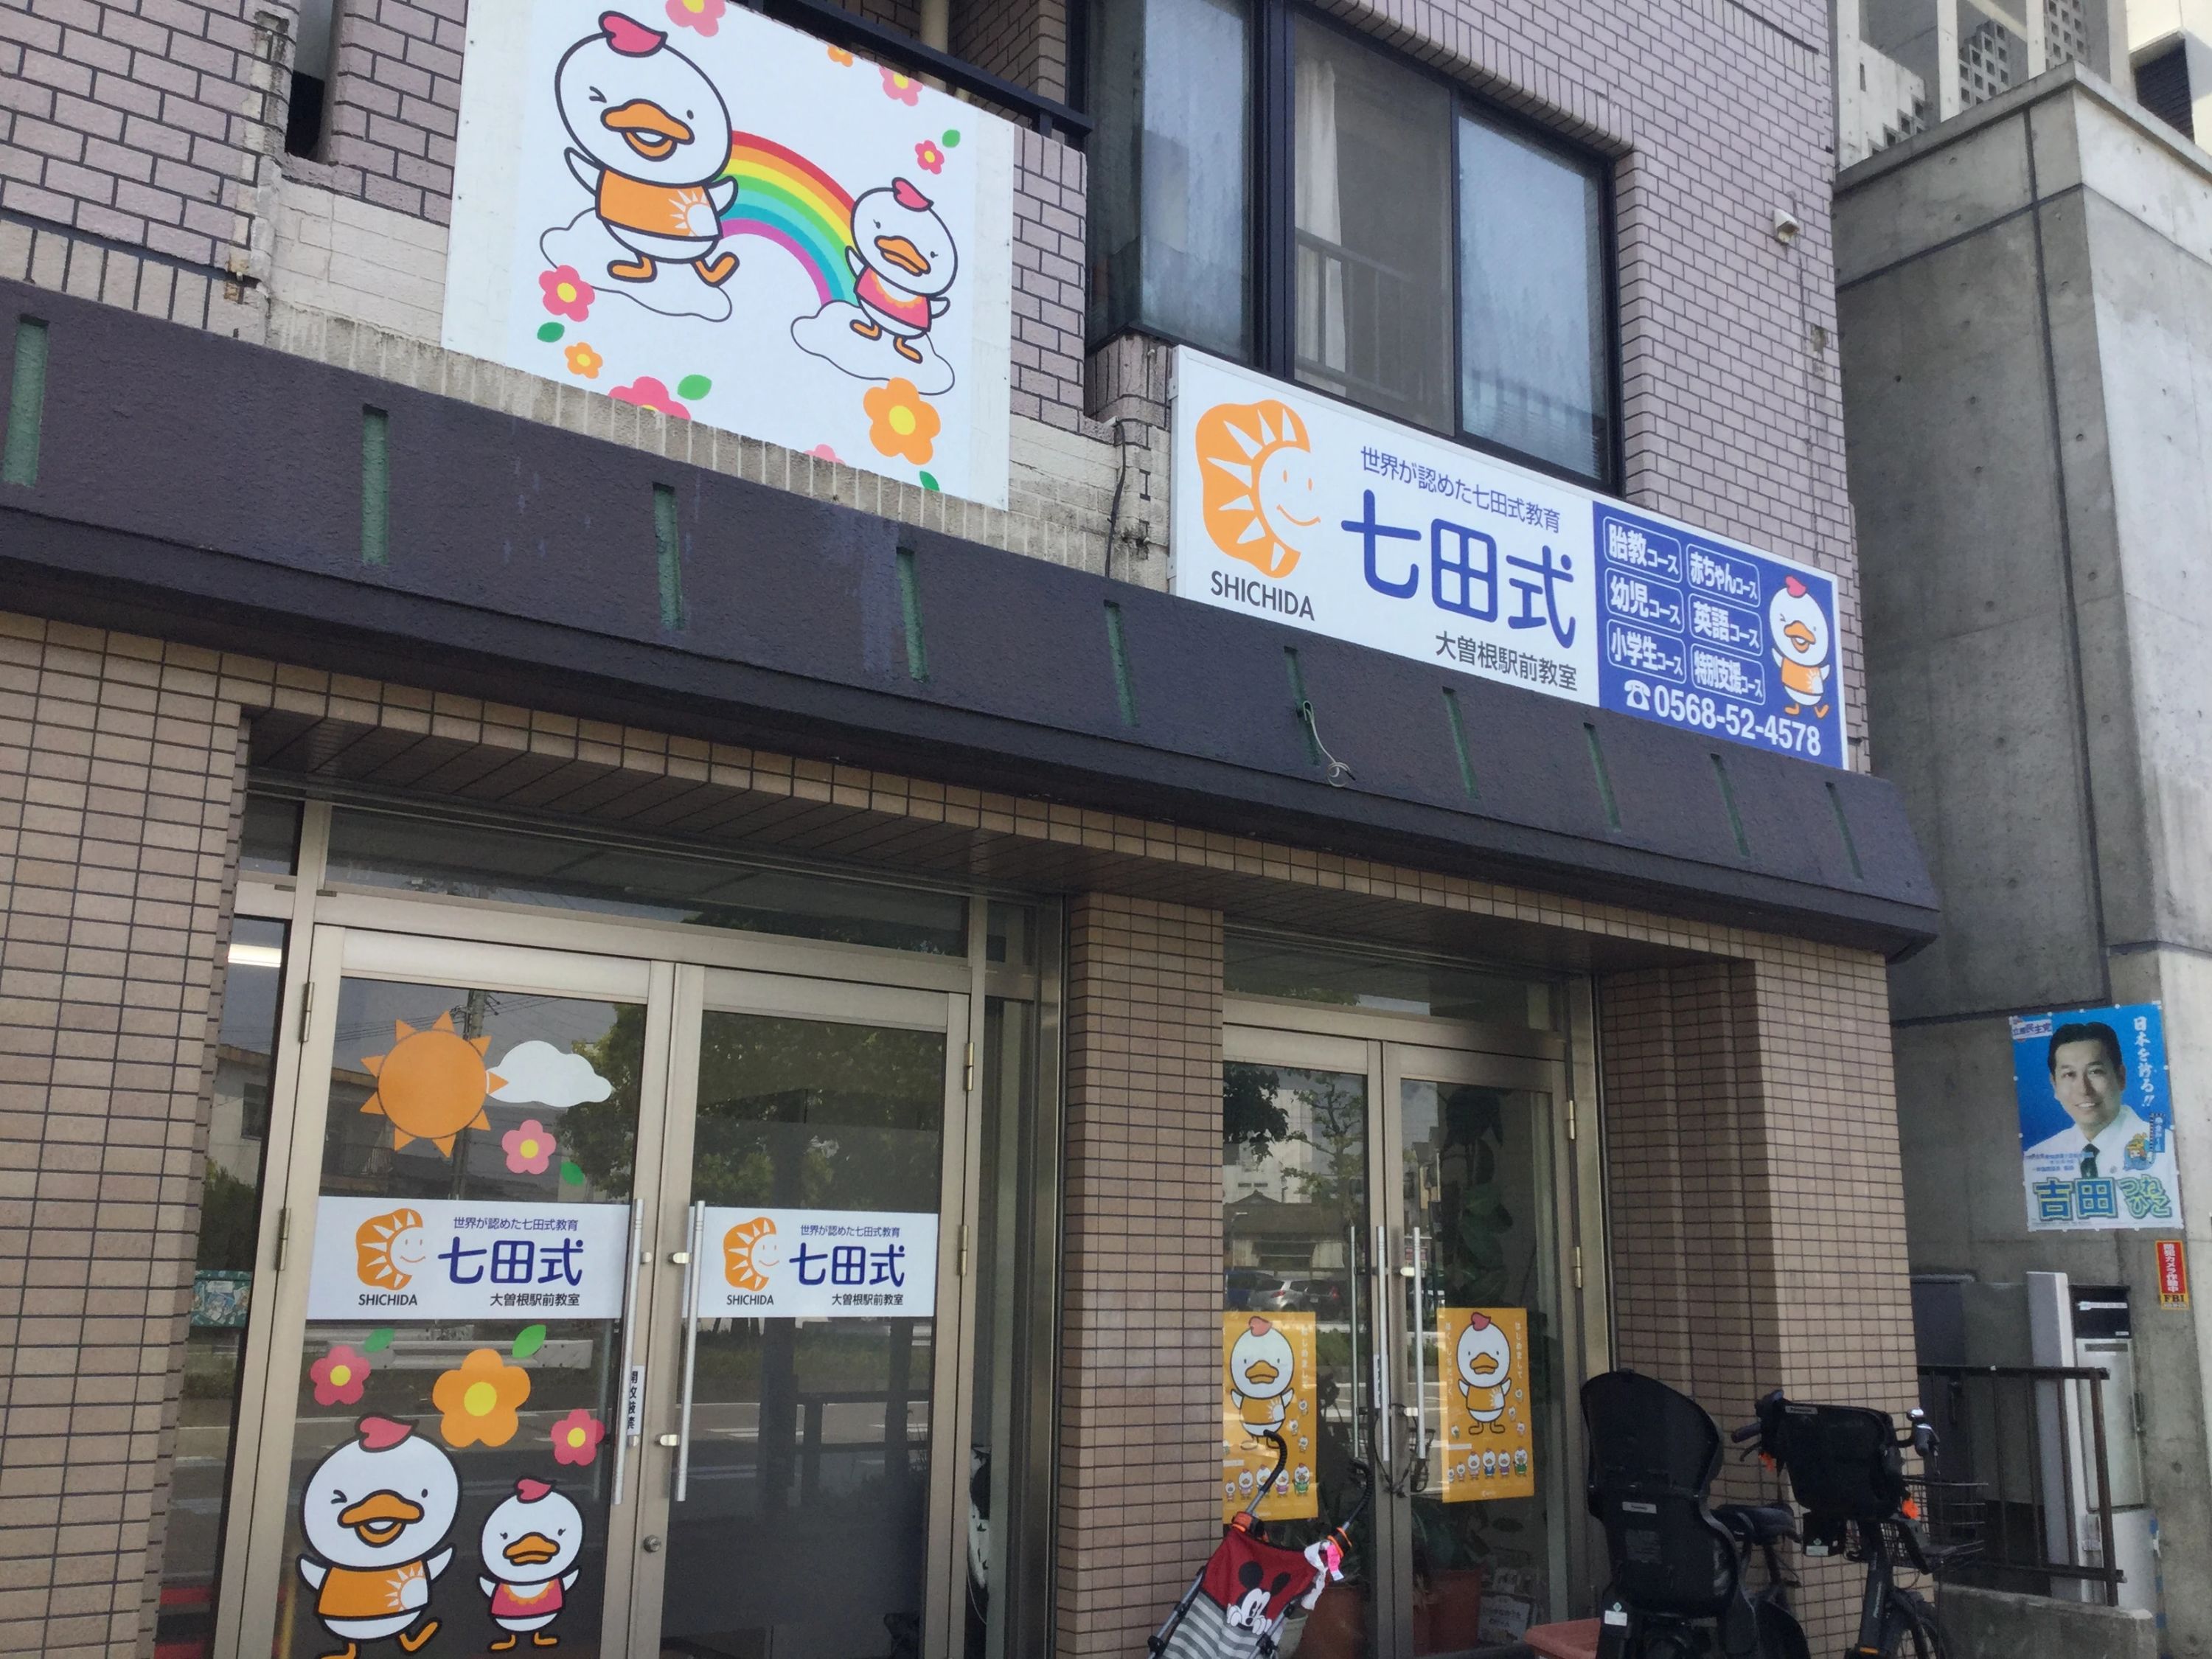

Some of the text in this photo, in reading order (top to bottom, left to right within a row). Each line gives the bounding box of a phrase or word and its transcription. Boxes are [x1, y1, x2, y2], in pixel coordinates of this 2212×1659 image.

[1360, 446, 1560, 534] 世界が認めた七田式教育
[1341, 489, 1576, 649] 七田式
[1609, 524, 1679, 575] 胎教コース
[1211, 571, 1315, 621] SHICHIDA
[1690, 552, 1758, 599] 赤ちゃんコース
[1610, 575, 1681, 625] 幼児コース
[1693, 600, 1759, 649] 英語コース
[1435, 630, 1578, 692] 大曽根駅前教室
[1611, 627, 1683, 676] 小学生コース
[1694, 650, 1763, 698] 特別支援コース
[1654, 685, 1821, 756] 0568-52-4578
[2033, 1177, 2118, 1221] 吉田
[453, 1217, 578, 1231] 世界が認めた七田式教育
[801, 1225, 900, 1238] 世界が認めた七田式教育
[438, 1237, 583, 1286] 七田式
[789, 1242, 905, 1287] 七田式
[358, 1294, 418, 1306] SHICHIDA
[490, 1293, 580, 1307] 大曽根駅前教室
[726, 1295, 774, 1305] SHICHIDA
[832, 1293, 903, 1306] 大曽根駅前教室
[2164, 1294, 2184, 1302] FBI
